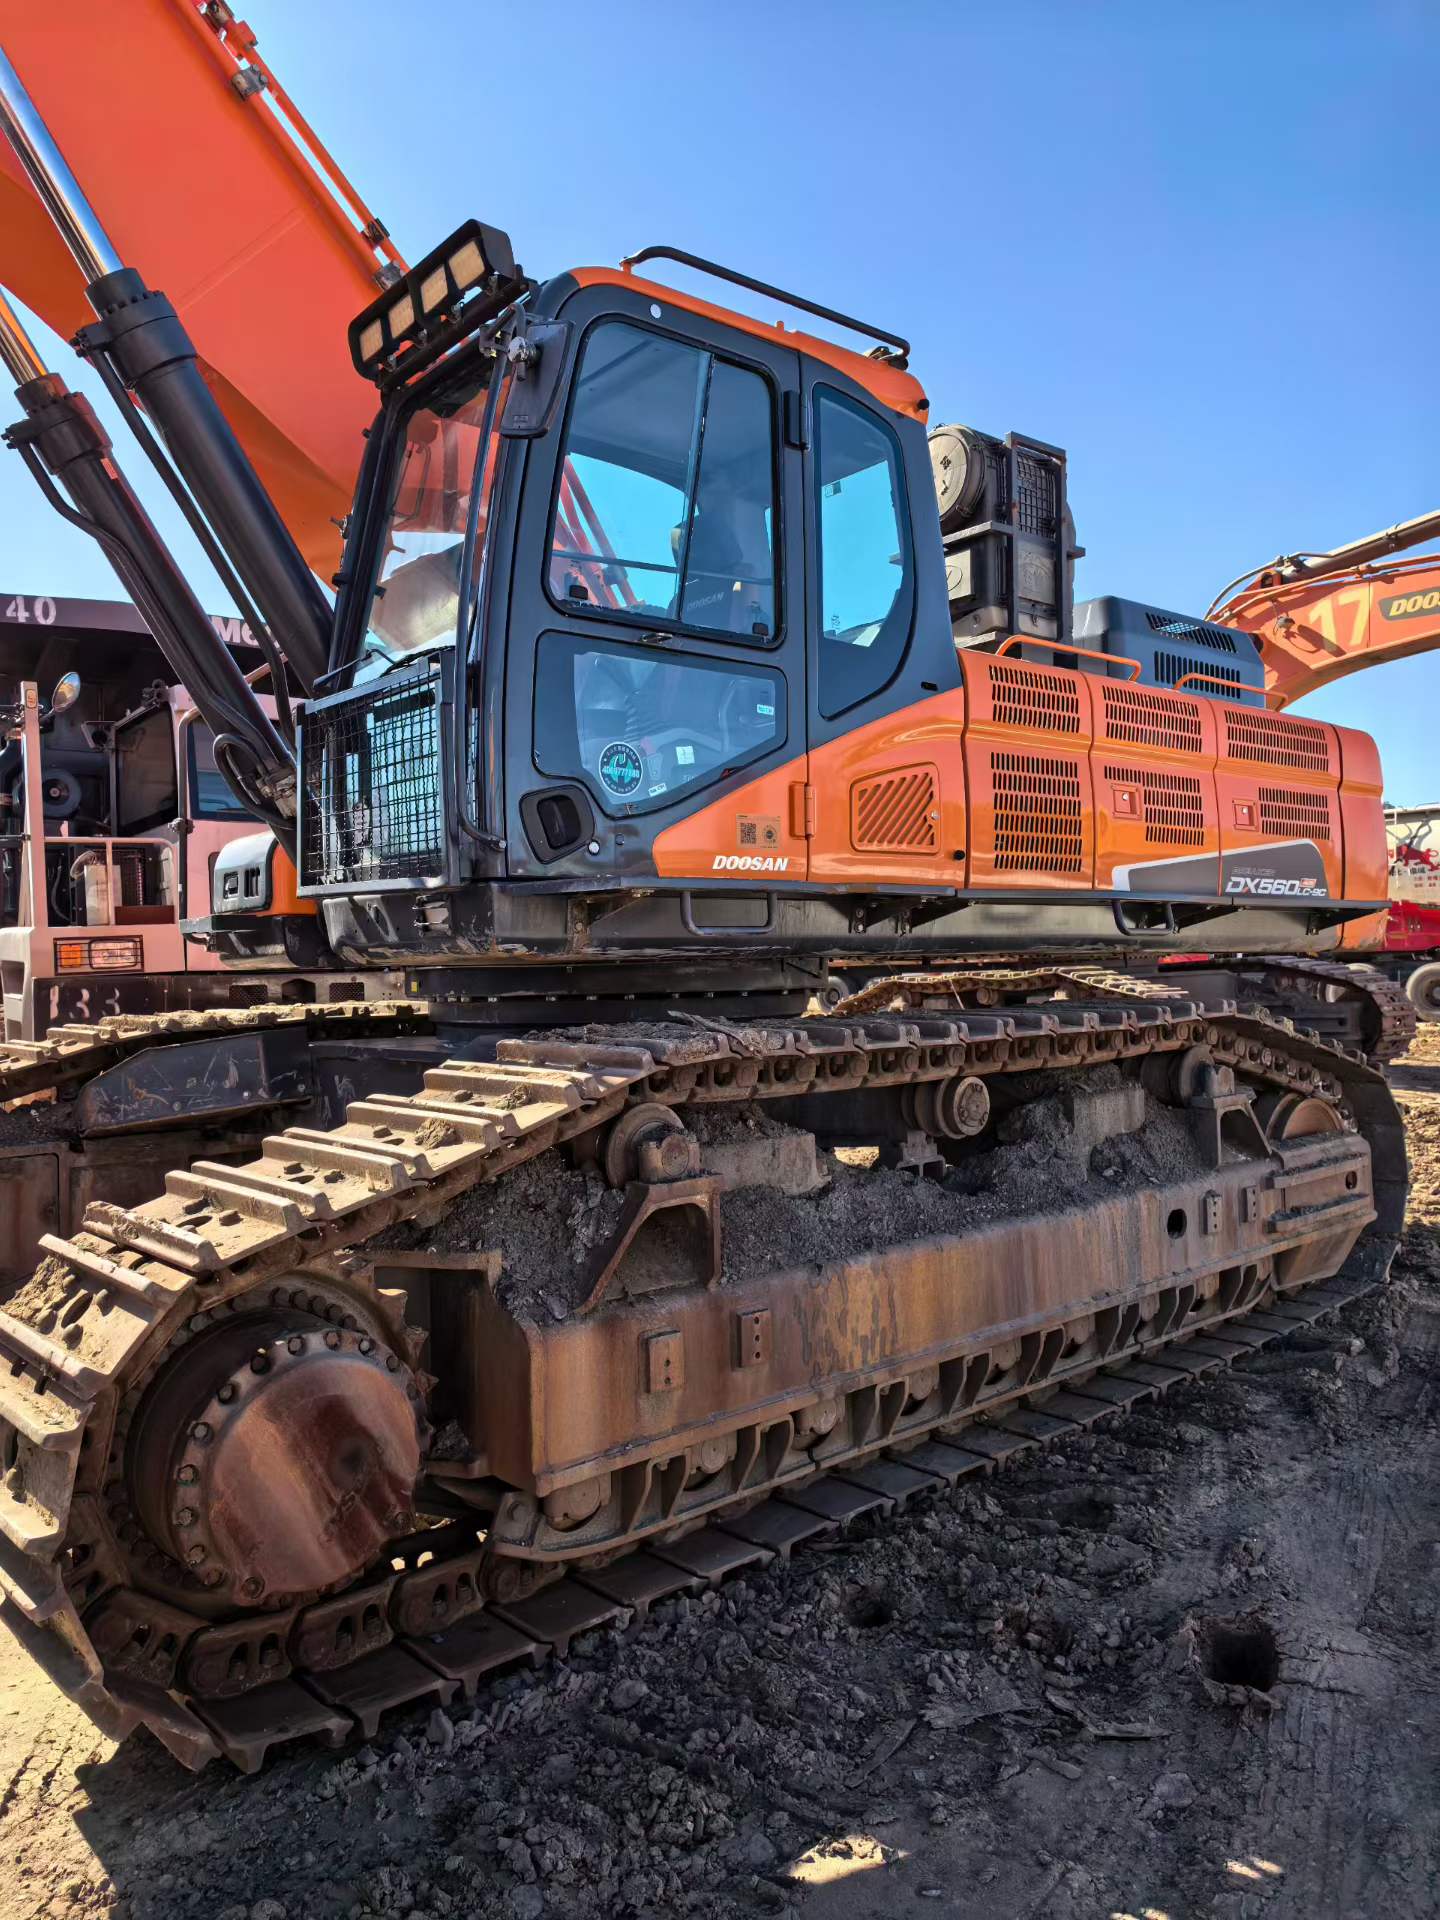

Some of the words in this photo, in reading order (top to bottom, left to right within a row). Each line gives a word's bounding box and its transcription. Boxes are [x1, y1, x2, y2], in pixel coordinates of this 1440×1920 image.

[5, 595, 57, 625] 40
[1389, 591, 1440, 617] DOO
[1308, 585, 1374, 652] 17
[712, 855, 789, 871] DOOSAN
